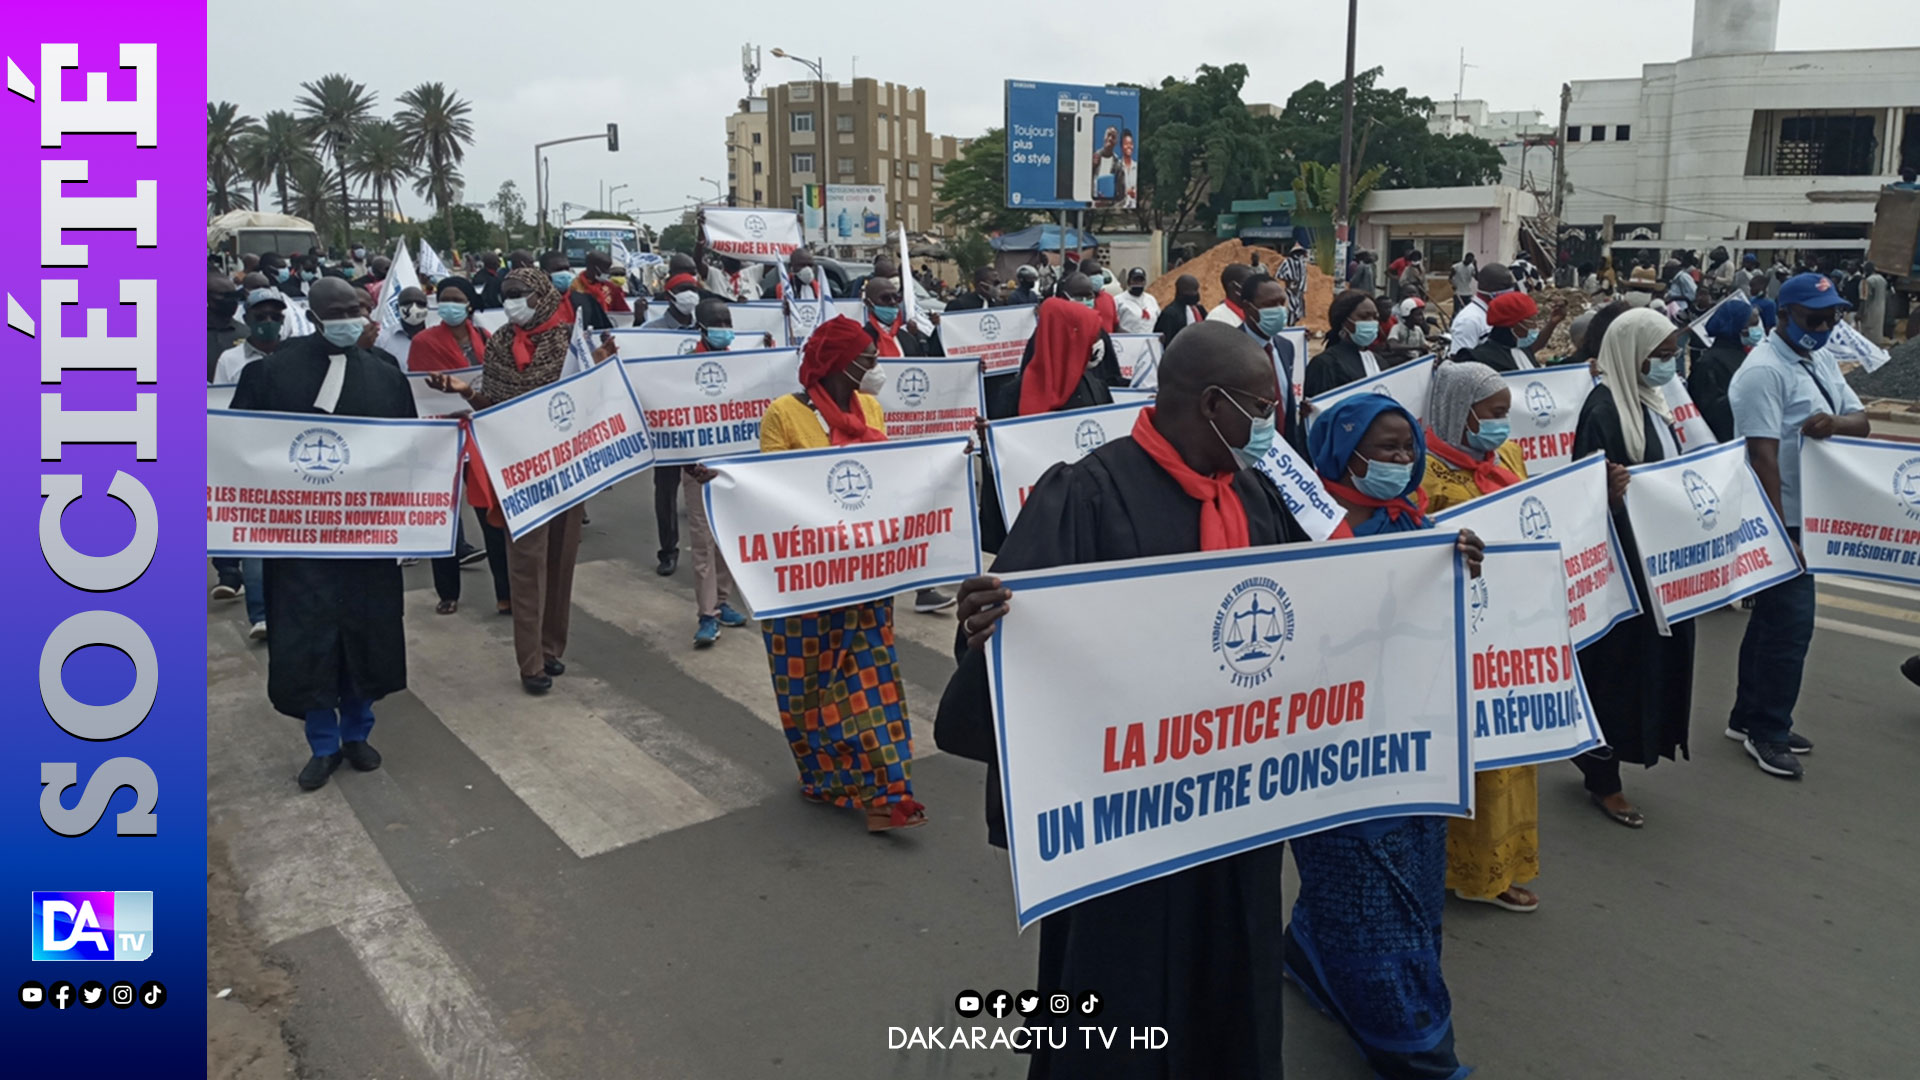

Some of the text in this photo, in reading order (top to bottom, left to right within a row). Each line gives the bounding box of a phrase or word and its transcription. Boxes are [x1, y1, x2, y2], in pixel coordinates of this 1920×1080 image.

[1013, 124, 1054, 140] Toujours
[1013, 140, 1034, 154] plus
[1013, 153, 1051, 167] de style
[712, 240, 754, 254] JUSTICE
[756, 242, 768, 254] EN
[694, 404, 718, 425] DES
[719, 398, 771, 421] DÉCRETS
[698, 427, 714, 447] DE
[716, 426, 731, 445] LA
[1539, 434, 1558, 459] EN
[501, 413, 627, 490] RESPECT DES DÉCRETS DU
[501, 431, 649, 520] PRÉSIDENT DE LA RÉPUBLIQUE
[1276, 454, 1335, 520] Syndicats
[215, 487, 237, 503] LES
[239, 488, 342, 506] RECLASSEMENTS
[344, 491, 366, 506] DES
[369, 492, 450, 508] TRAVAILLEURS
[215, 507, 268, 524] JUSTICE
[269, 509, 303, 524] DANS
[305, 509, 343, 525] LEURS
[345, 510, 407, 525] NOUVEAUX
[408, 510, 447, 526] CORPS
[232, 526, 399, 545] ET NOUVELLES HIÉRARCHIES
[738, 507, 953, 563] LA VÉRITÉ ET LE DROIT
[1820, 518, 1830, 533] LE
[1831, 519, 1878, 539] RESPECT
[1880, 526, 1895, 542] DE
[1658, 552, 1668, 575] LE
[1669, 540, 1711, 572] PAIEMENT
[1827, 540, 1841, 556] DU
[1842, 541, 1902, 563] PRÉSIDENT
[1901, 550, 1917, 566] DE
[774, 542, 929, 593] TRIOMPHERONT
[1565, 555, 1581, 578] DES
[1661, 567, 1720, 605] TRAVAILLEURS
[1212, 609, 1225, 653] SYNDICAT
[1221, 593, 1234, 610] DES
[1282, 597, 1292, 610] LA
[1472, 644, 1559, 690] DÉCRETS
[1103, 680, 1366, 773] LA JUSTICE POUR
[1037, 730, 1432, 862] UN MINISTRE CONSCIENT
